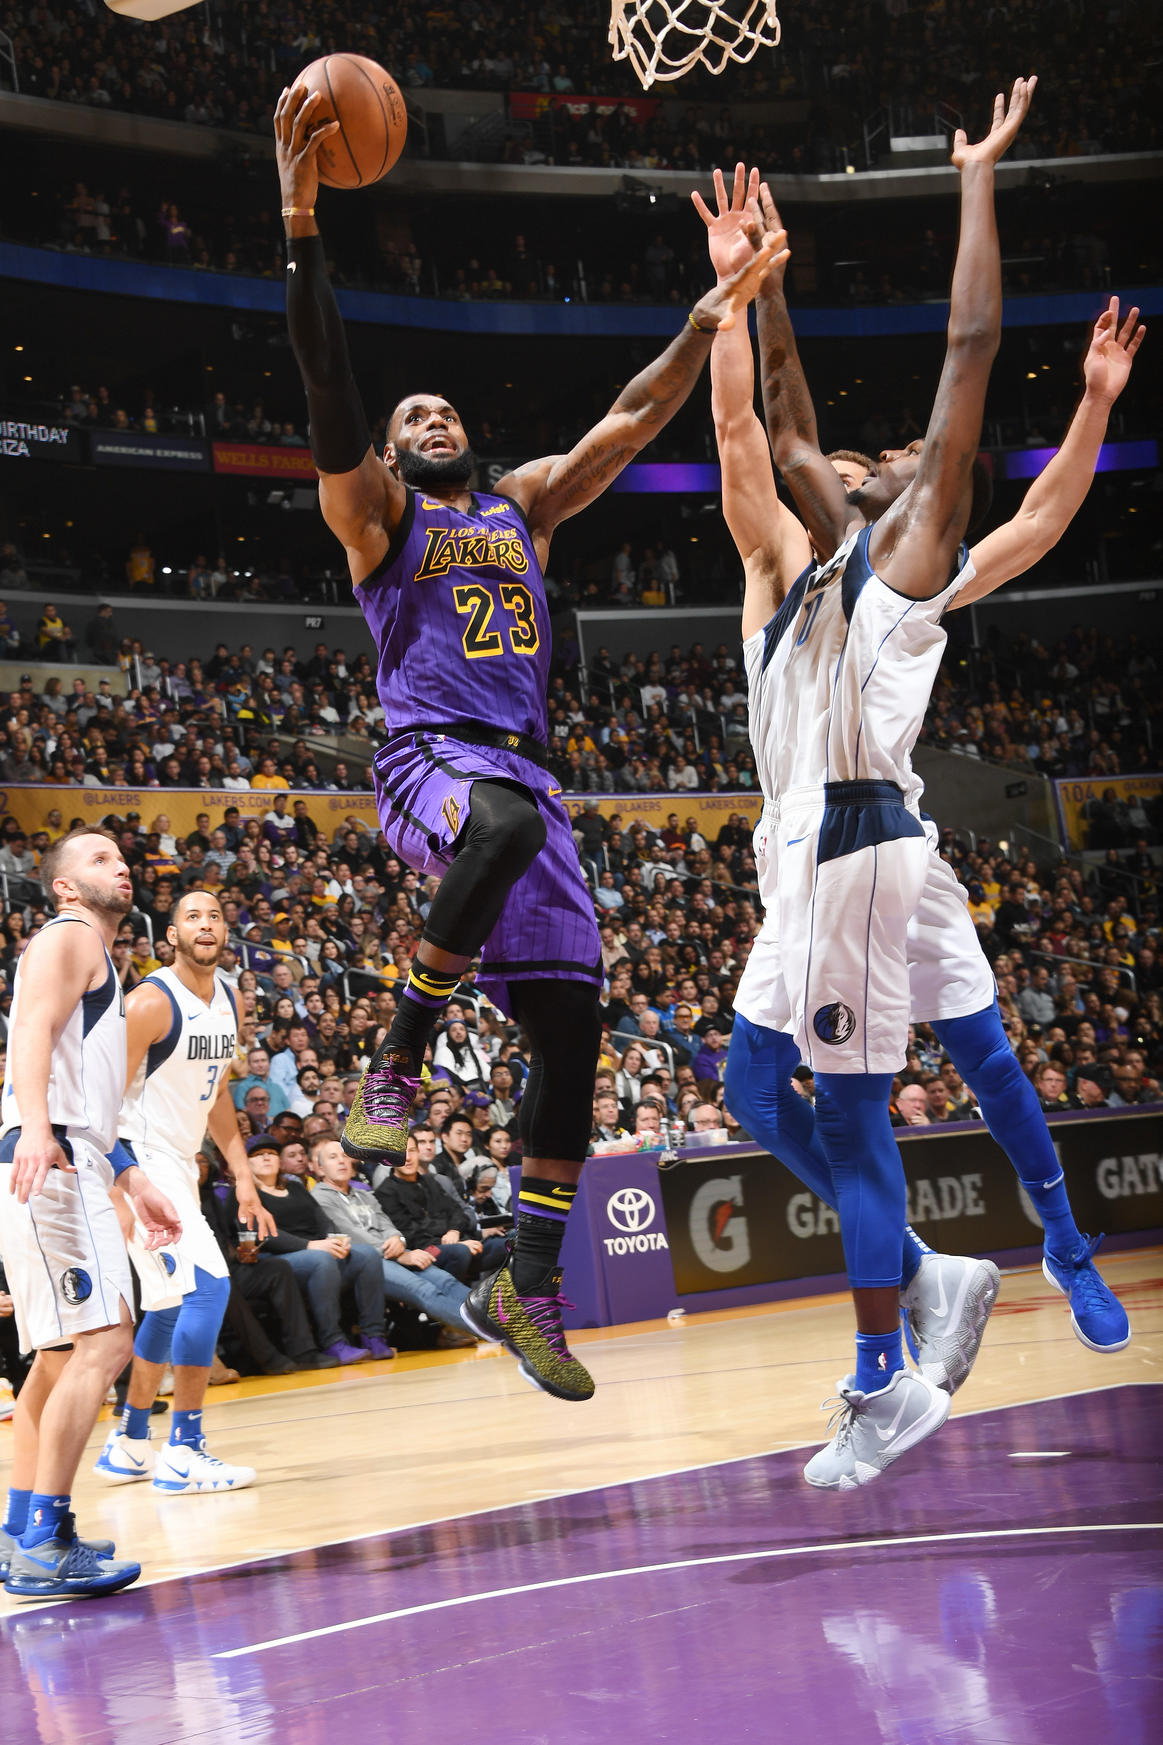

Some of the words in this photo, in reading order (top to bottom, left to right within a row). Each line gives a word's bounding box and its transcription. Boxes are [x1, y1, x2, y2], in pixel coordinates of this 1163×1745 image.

[0, 420, 69, 444] IRTHDAY
[0, 439, 30, 457] IZA
[96, 445, 153, 456] AMERICAN
[156, 449, 203, 460] EXPRESS
[216, 451, 269, 467] WELLS
[480, 503, 510, 517] wish
[449, 527, 475, 538] LOS
[453, 583, 540, 659] 23
[83, 793, 141, 806] @LAKERS
[202, 795, 271, 808] LAKERS.COM
[615, 801, 662, 813] @LAKERS
[701, 799, 758, 810] LAKERS.COM
[187, 1034, 235, 1060] DALLAS
[1096, 1153, 1163, 1199] GAT
[787, 1173, 985, 1238] GAADE
[688, 1175, 751, 1273] G
[603, 1232, 669, 1256] TOYOTA
